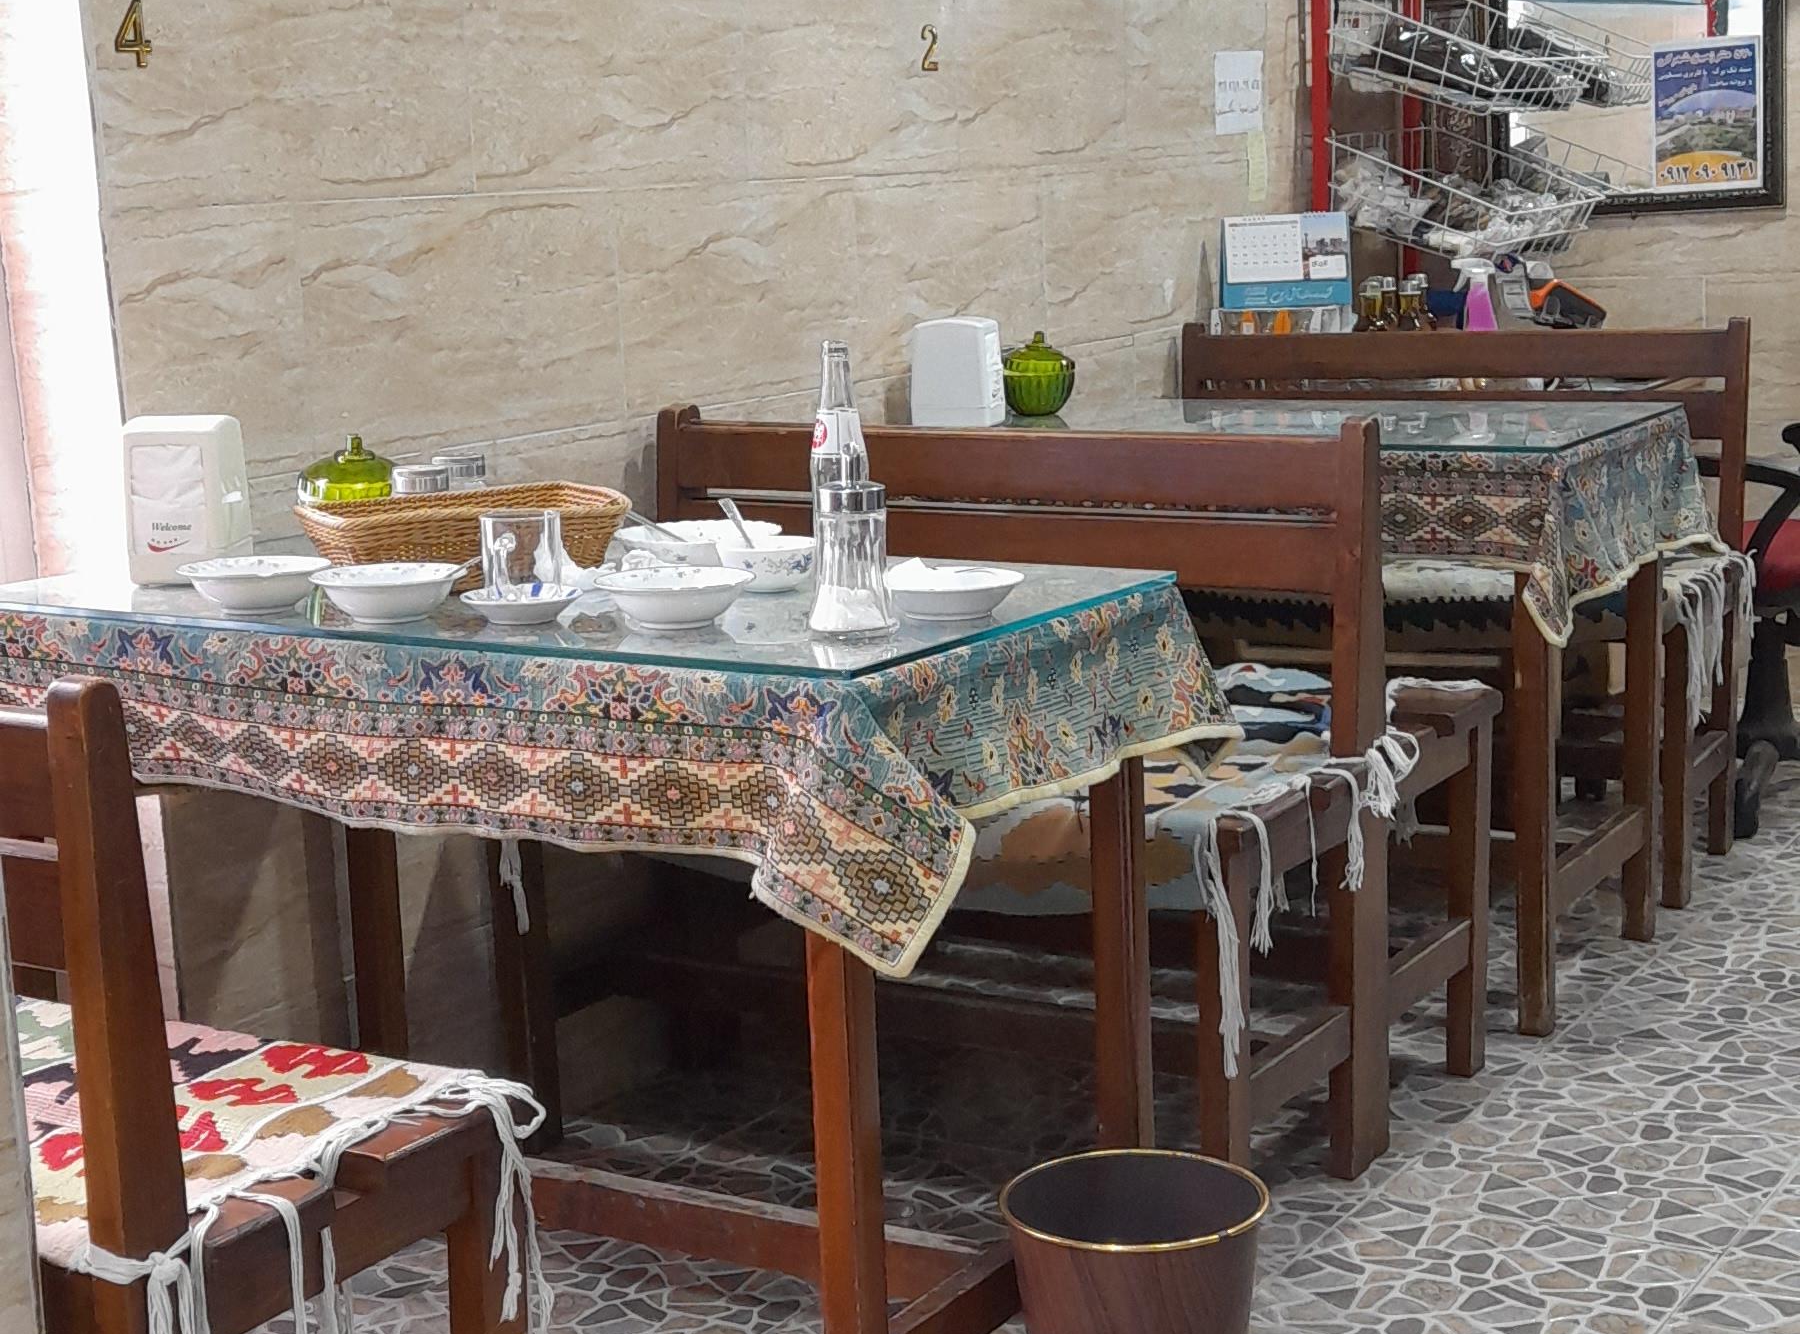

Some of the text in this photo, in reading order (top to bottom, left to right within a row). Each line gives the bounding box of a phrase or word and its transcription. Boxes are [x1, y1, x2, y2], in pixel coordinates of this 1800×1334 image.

[115, 0, 152, 67] 4
[921, 23, 939, 71] 2
[151, 522, 193, 532] Welcome
